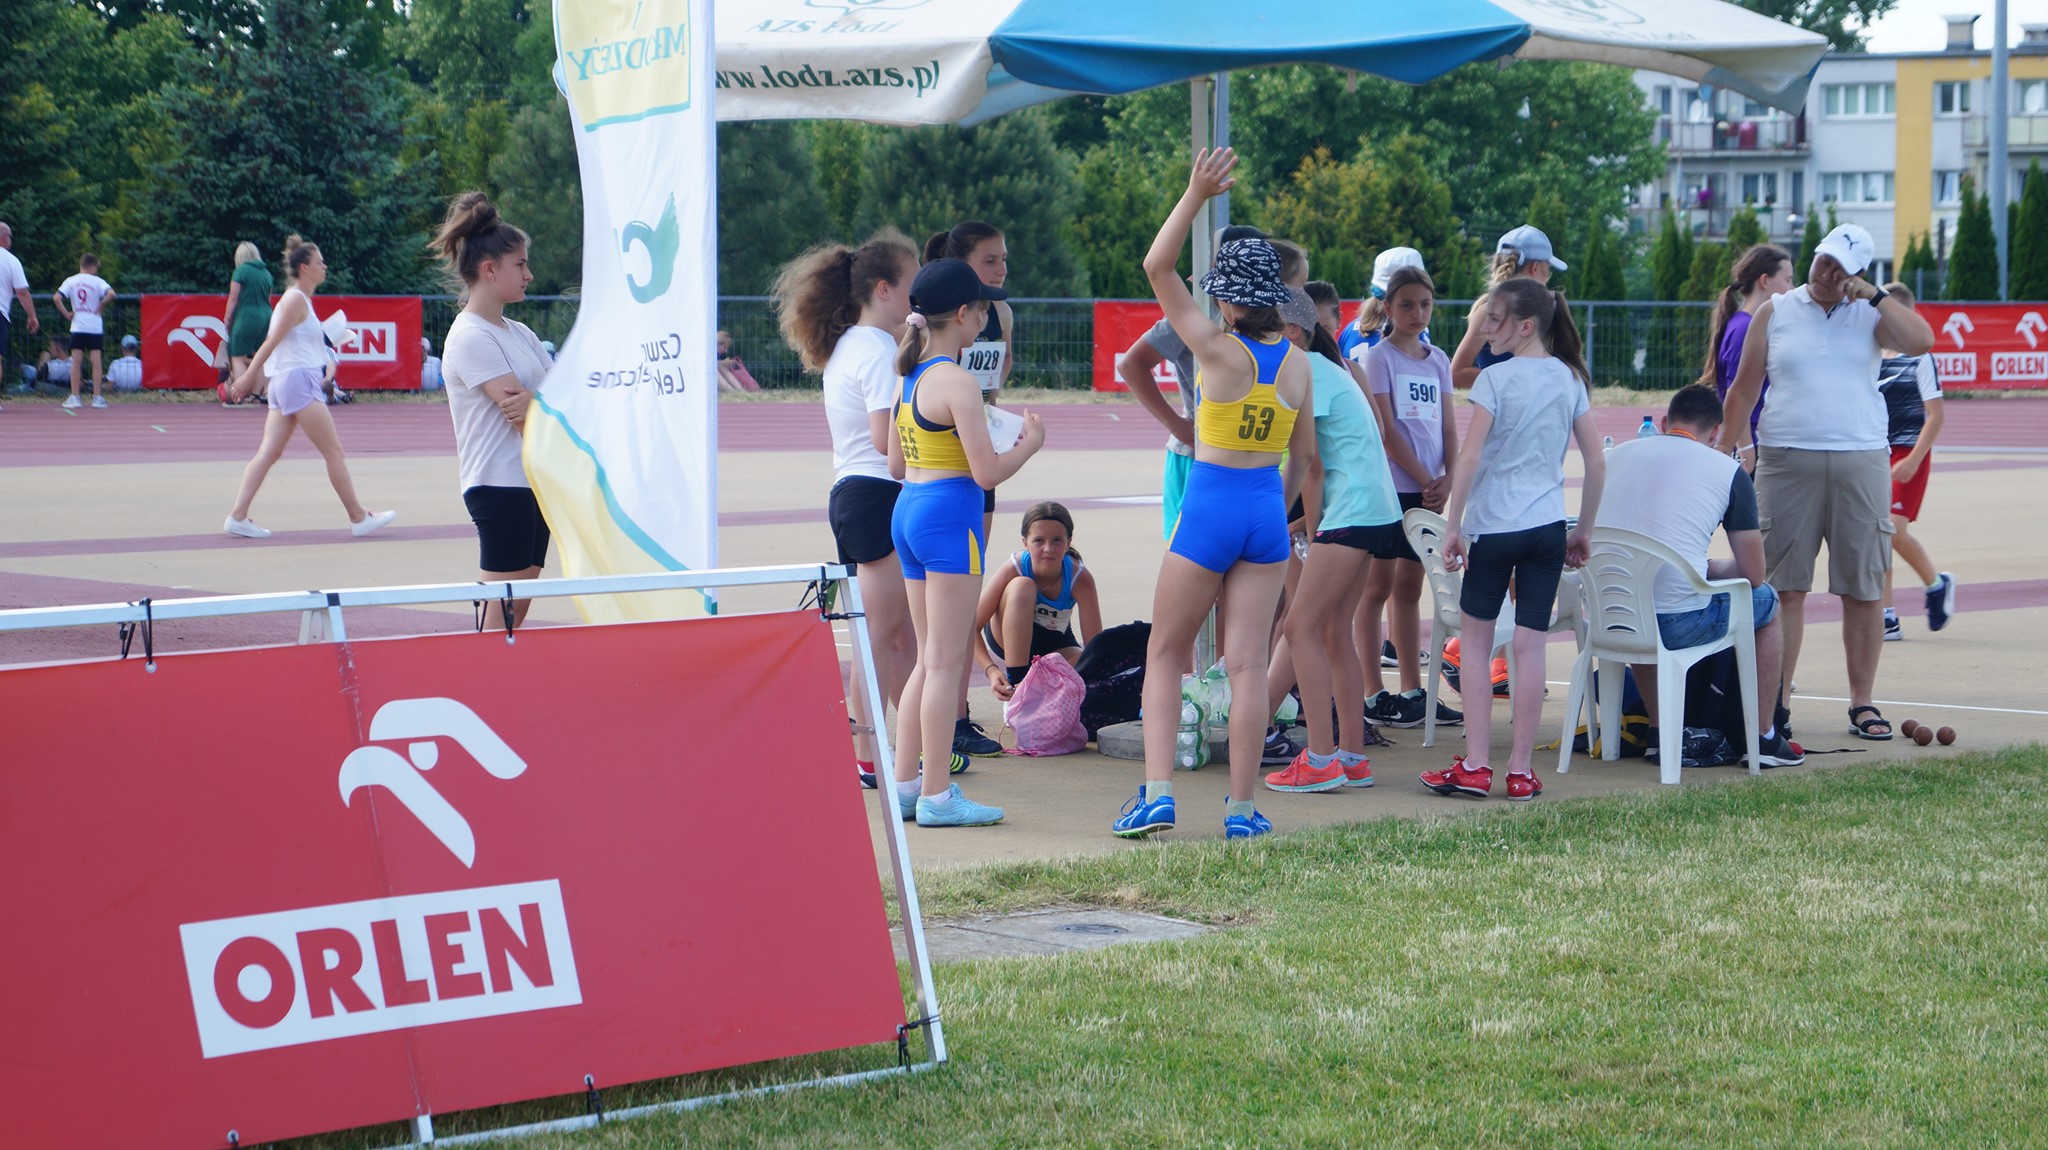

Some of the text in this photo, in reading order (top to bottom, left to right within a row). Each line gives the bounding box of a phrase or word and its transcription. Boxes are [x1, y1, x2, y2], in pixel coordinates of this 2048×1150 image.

[78, 289, 87, 304] 9
[968, 350, 999, 371] 1028
[1936, 358, 1972, 376] RLEN
[1996, 356, 2045, 375] ORLEN
[1409, 382, 1437, 404] 590
[1238, 404, 1275, 442] 53
[213, 902, 555, 1029] ORLEN
